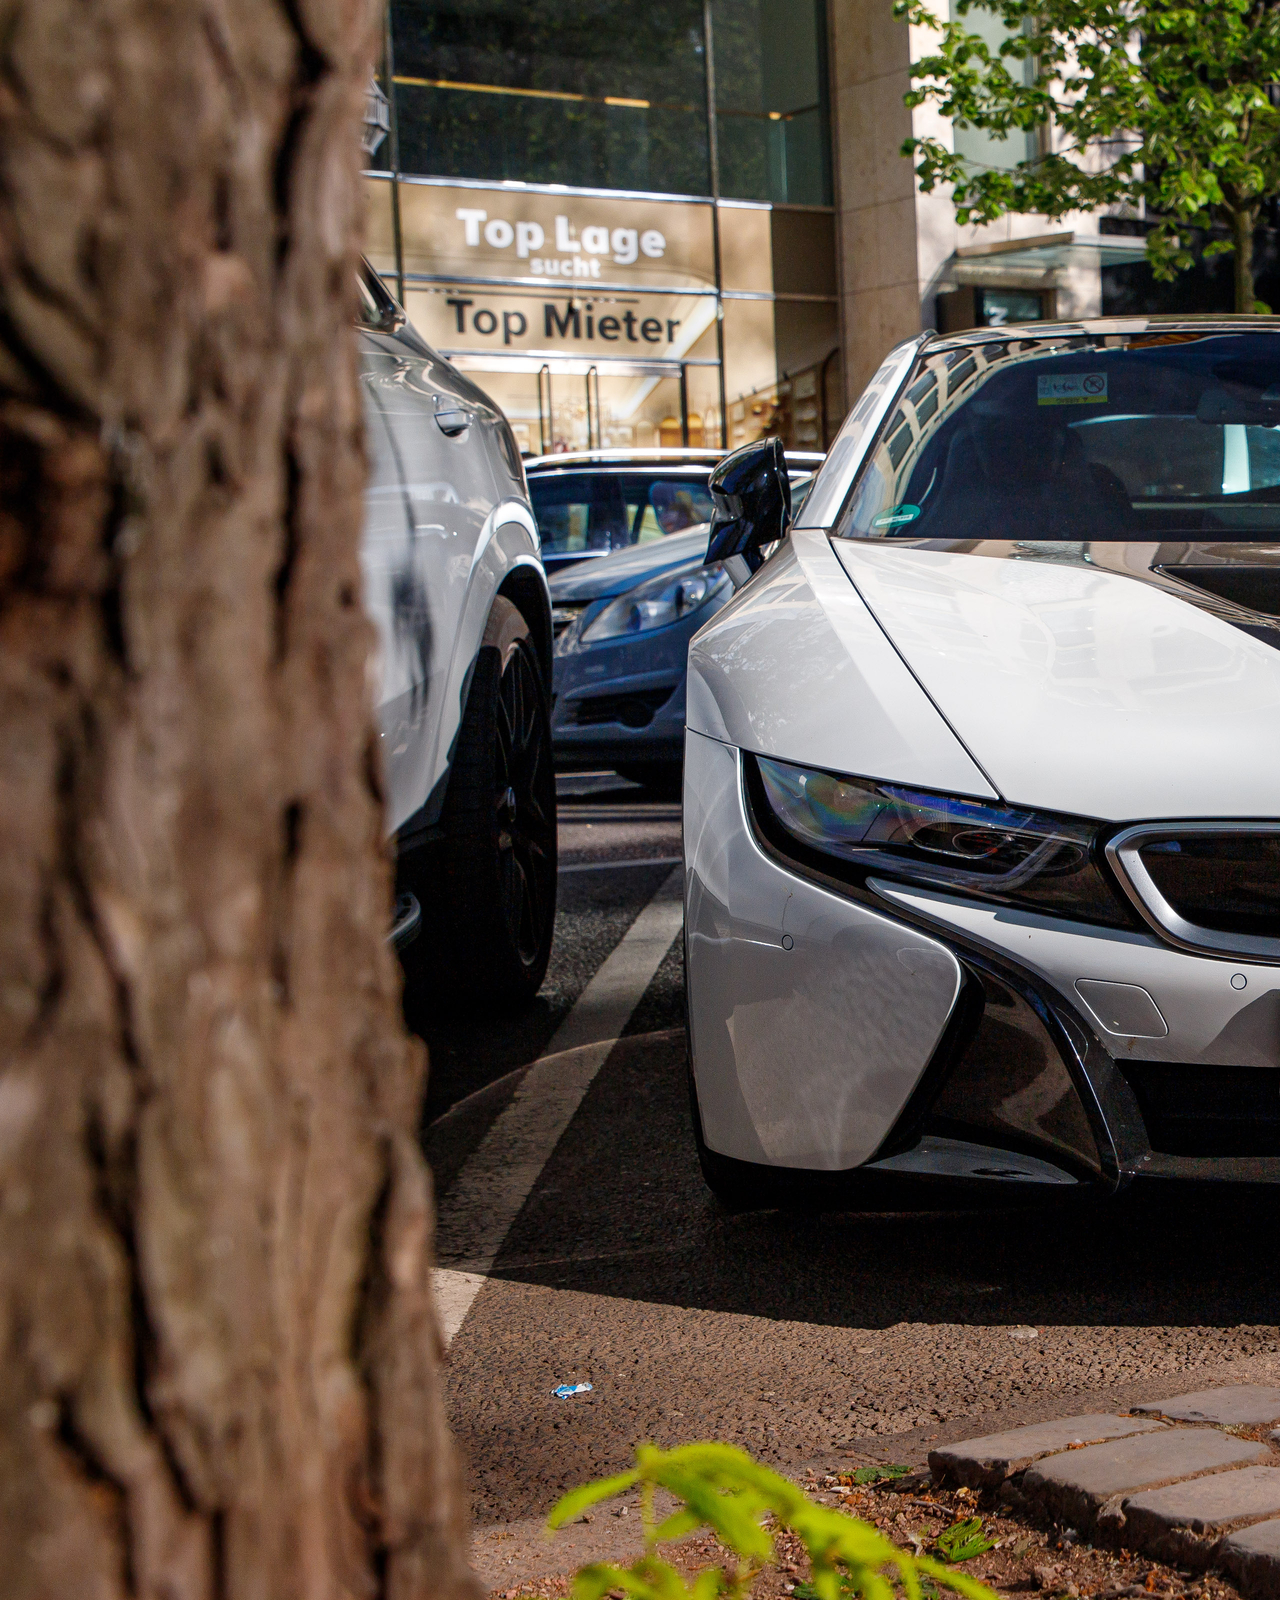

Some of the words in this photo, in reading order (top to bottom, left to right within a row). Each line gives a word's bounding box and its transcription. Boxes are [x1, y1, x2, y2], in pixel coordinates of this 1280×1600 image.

[456, 208, 545, 258] Top
[555, 215, 667, 265] Lage
[529, 256, 601, 278] sucht
[447, 299, 528, 344] Top
[544, 302, 680, 343] Mieter
